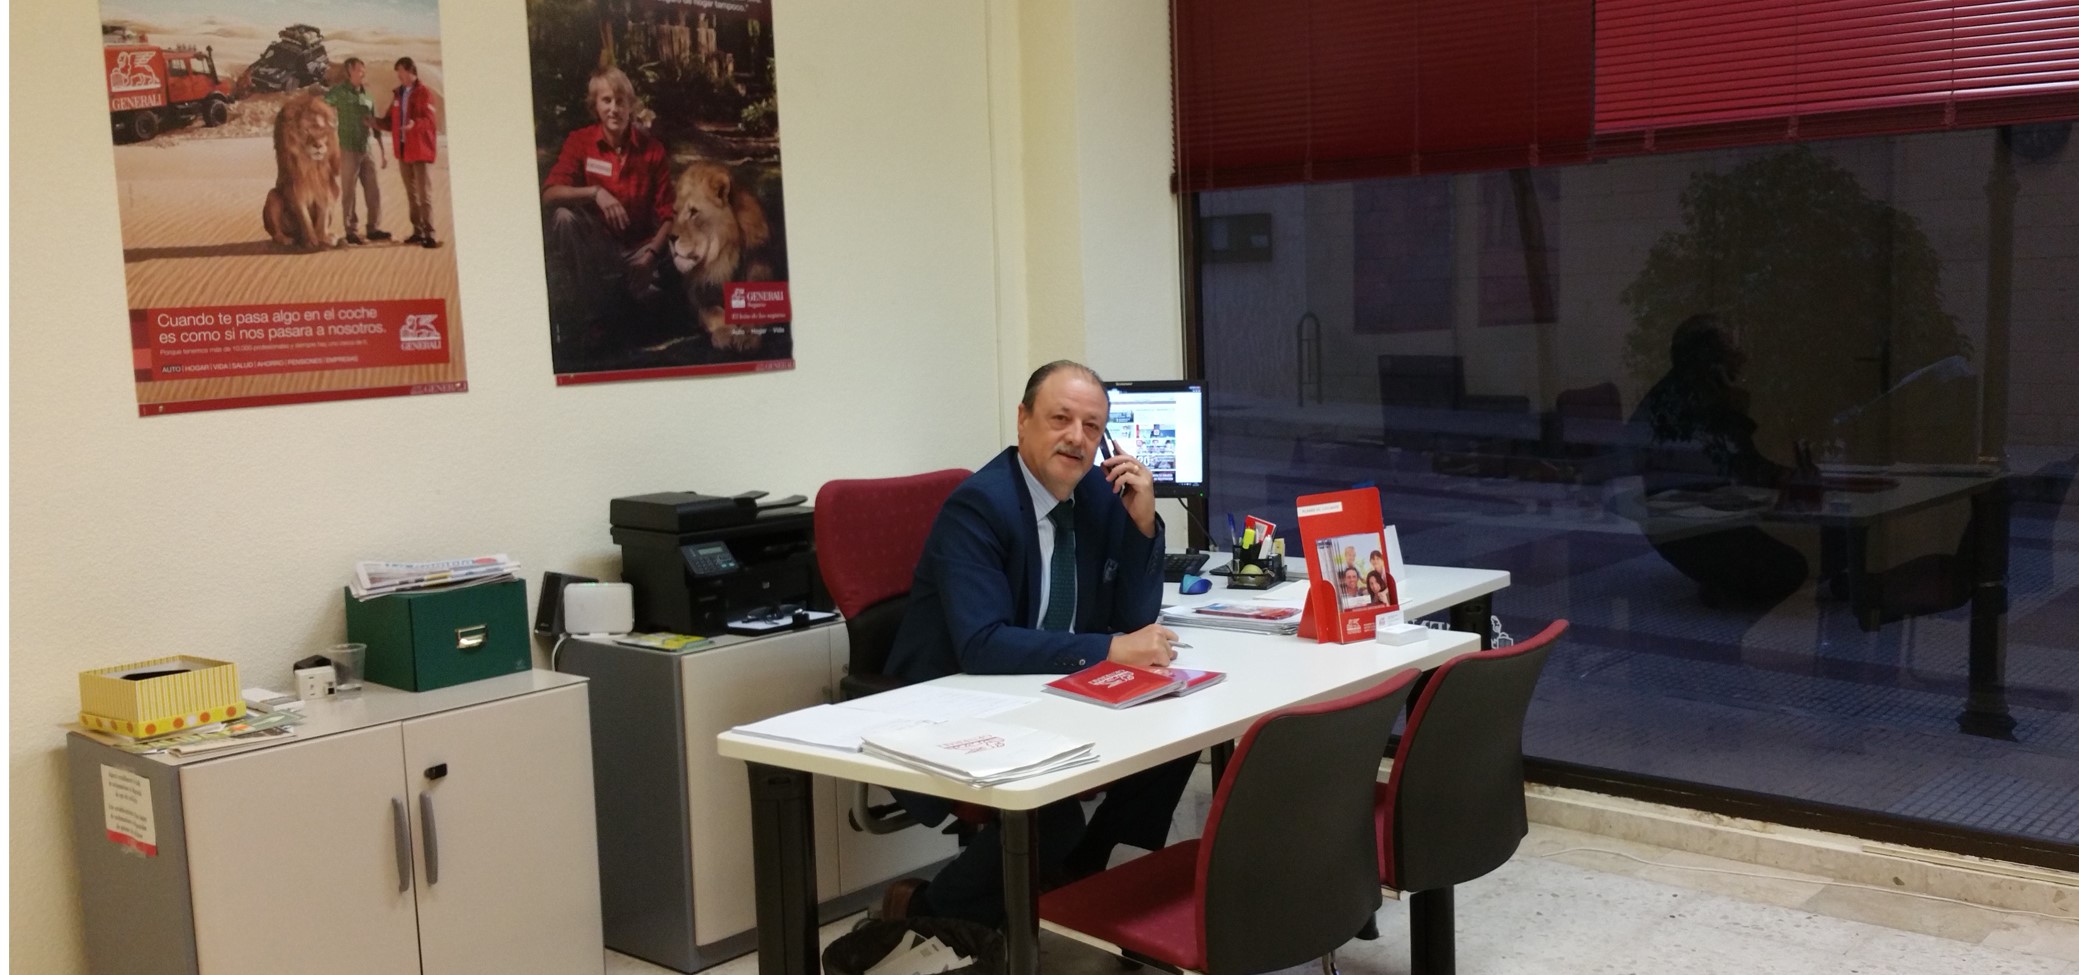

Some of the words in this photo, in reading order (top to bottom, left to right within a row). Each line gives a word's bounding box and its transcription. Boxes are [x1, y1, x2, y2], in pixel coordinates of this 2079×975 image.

[112, 94, 161, 110] GENERALI
[747, 291, 784, 301] GENERALI
[157, 312, 214, 327] Cuando
[218, 312, 232, 325] te
[235, 312, 268, 327] pasa
[272, 309, 301, 325] algo
[304, 310, 320, 321] en
[323, 307, 335, 320] el
[338, 306, 377, 320] coche
[159, 333, 177, 344] es
[180, 330, 220, 343] como
[224, 327, 236, 341] si
[240, 328, 265, 340] nos
[268, 325, 313, 341] pasara
[316, 325, 325, 336] a
[328, 322, 387, 336] nosotros.
[401, 341, 441, 351] GENERALI
[185, 364, 209, 372] HOGAR
[231, 361, 254, 369] SALUD
